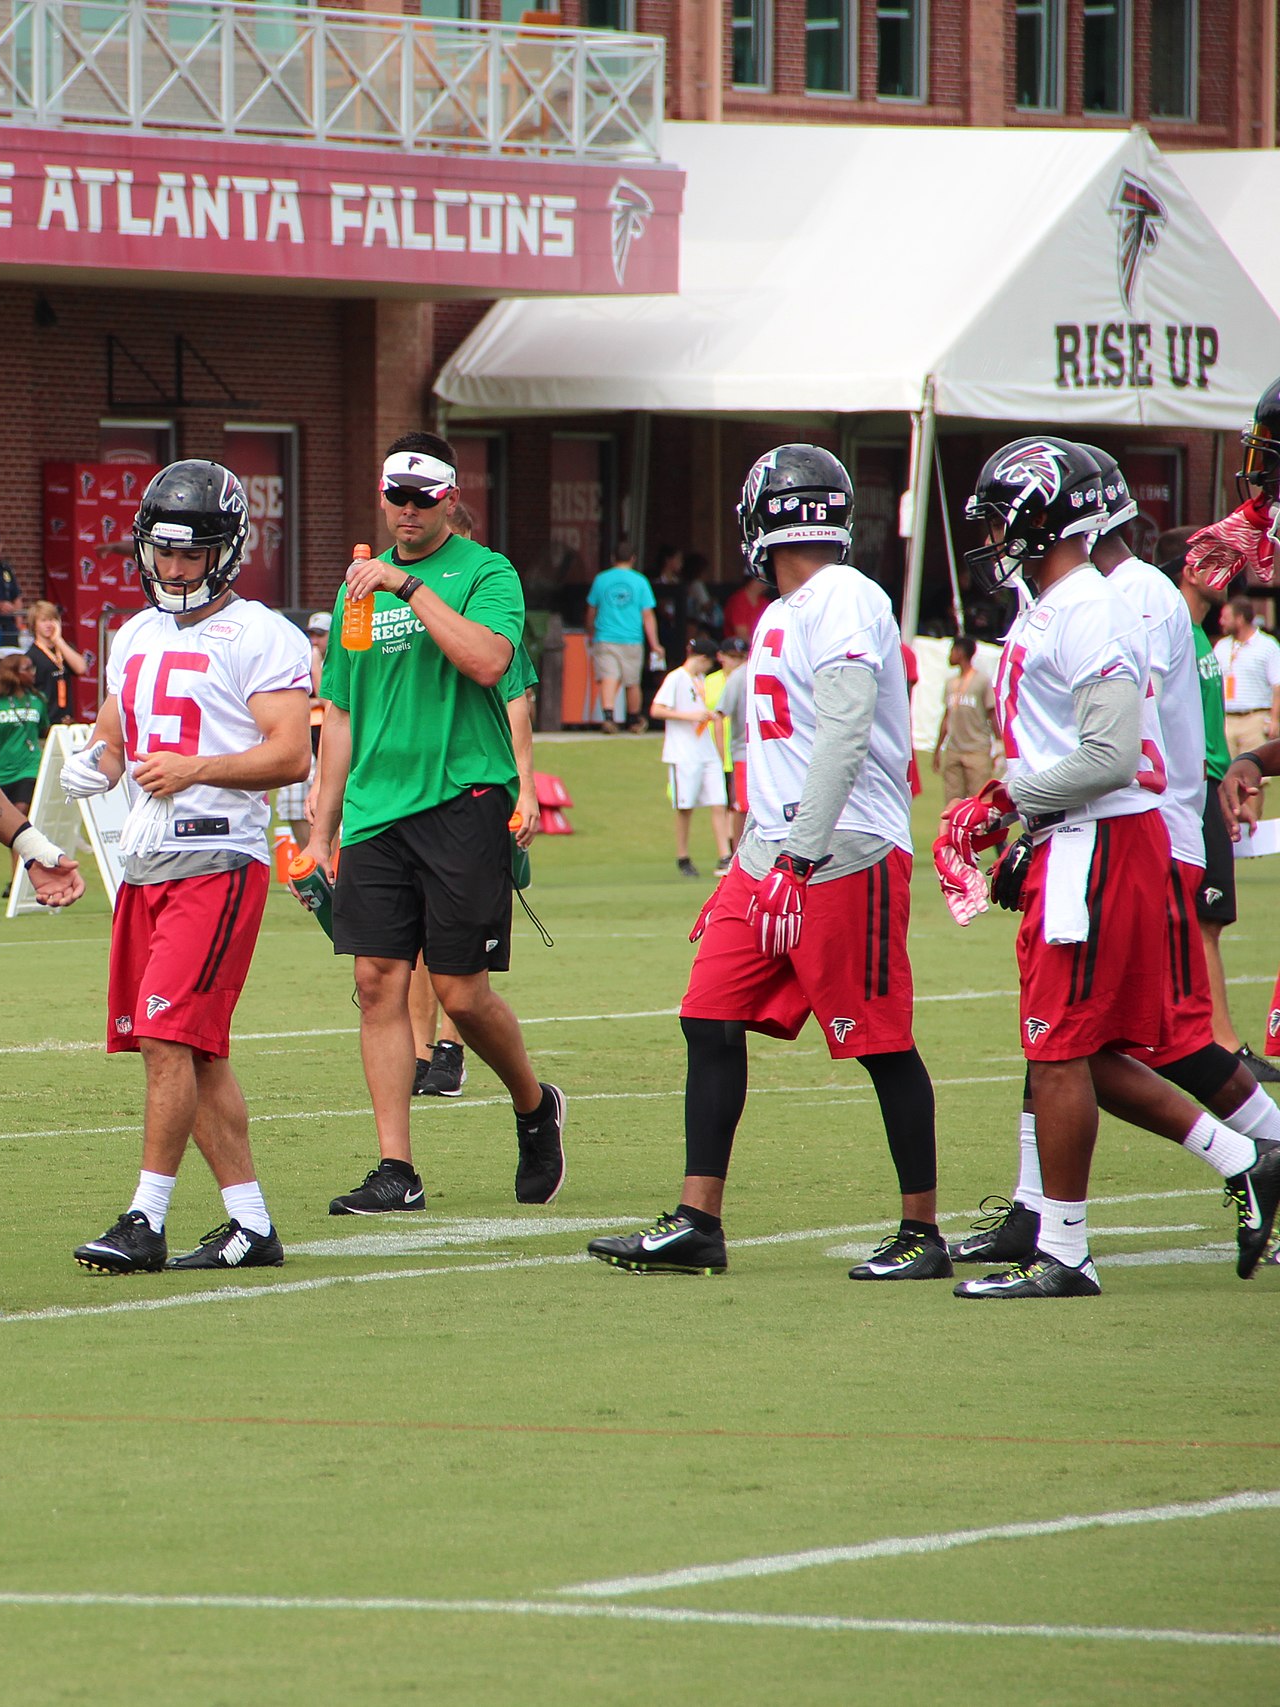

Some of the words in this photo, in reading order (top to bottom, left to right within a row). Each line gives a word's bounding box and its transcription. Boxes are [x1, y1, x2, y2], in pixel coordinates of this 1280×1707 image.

[37, 164, 304, 243] ATLANTA
[330, 182, 577, 257] FALCONS
[1054, 323, 1153, 388] RISE
[1166, 325, 1219, 388] UP
[801, 502, 827, 521] 16
[786, 530, 838, 538] FALCONS
[371, 606, 411, 626] RISE
[381, 642, 411, 655] Novelis
[121, 651, 211, 762] 15
